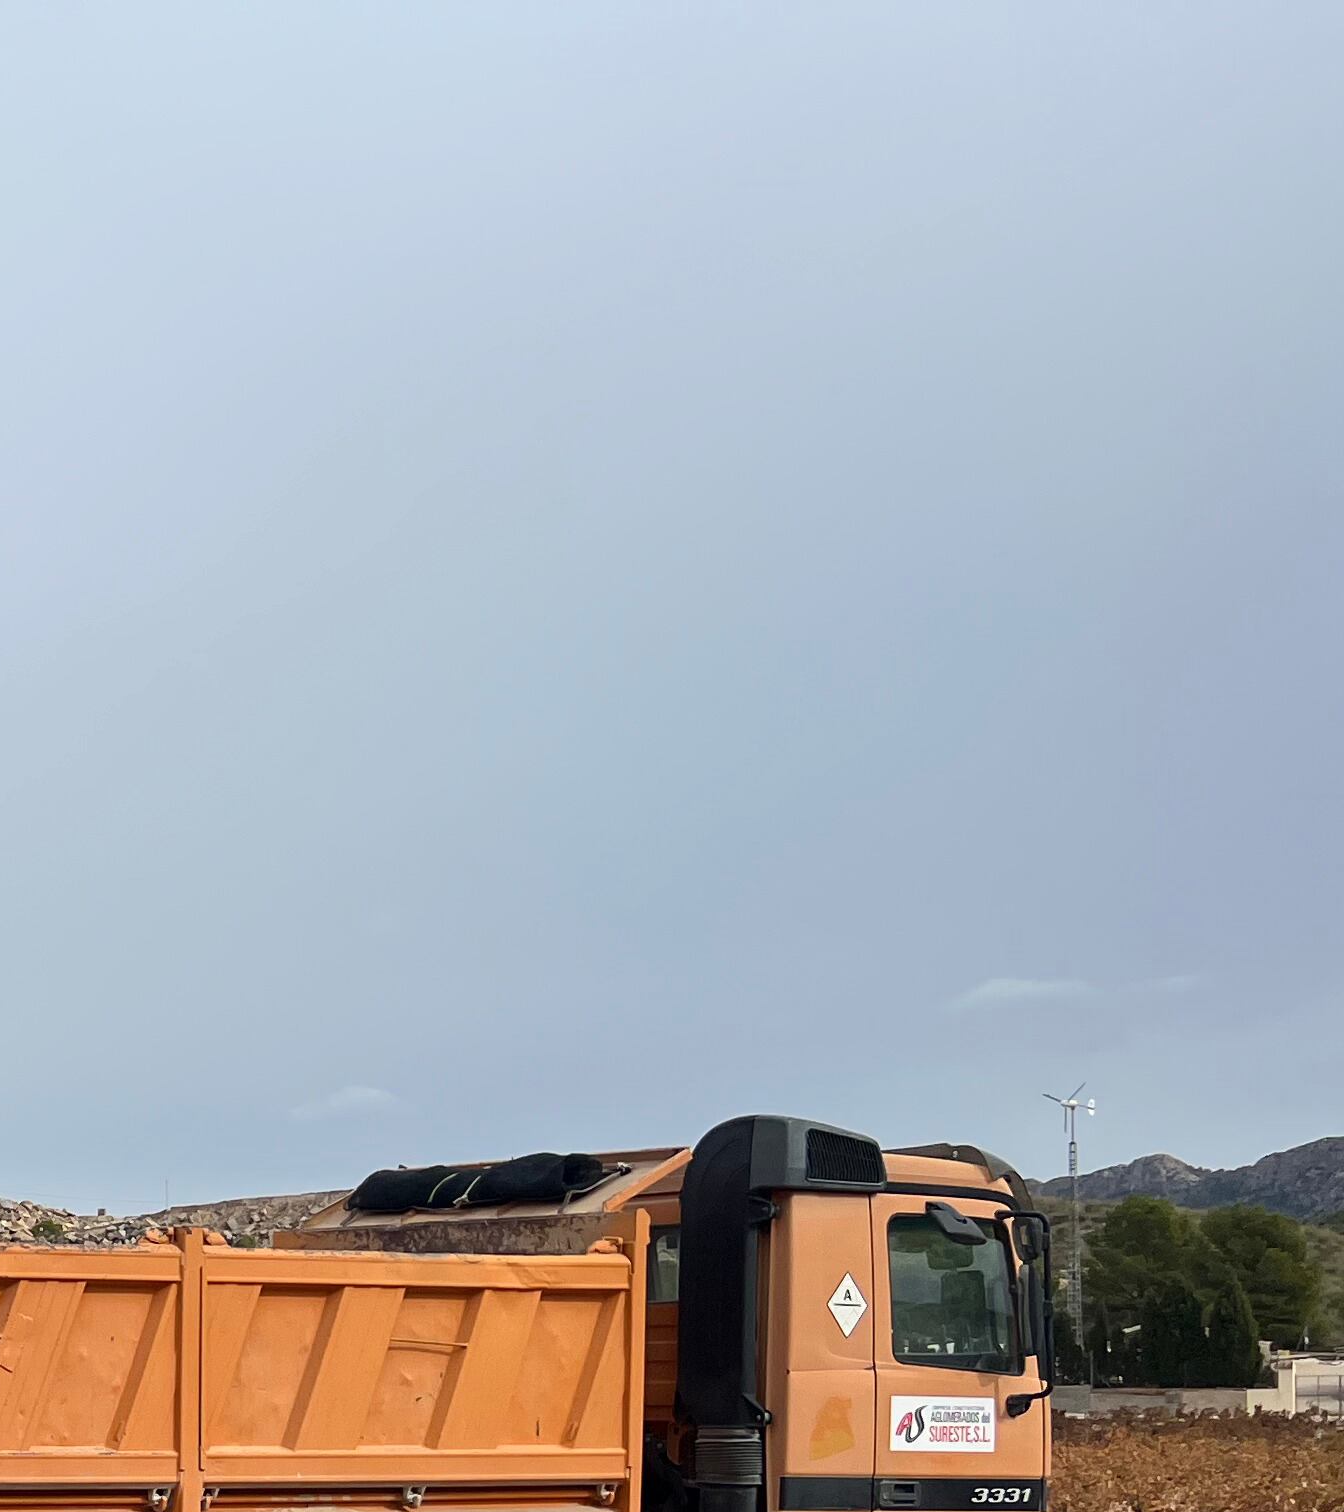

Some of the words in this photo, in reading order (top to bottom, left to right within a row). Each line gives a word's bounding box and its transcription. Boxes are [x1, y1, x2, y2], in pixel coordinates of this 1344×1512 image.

[843, 1289, 853, 1301] A
[930, 1411, 980, 1423] AGLOMERADOS
[971, 1487, 1032, 1503] 3331
